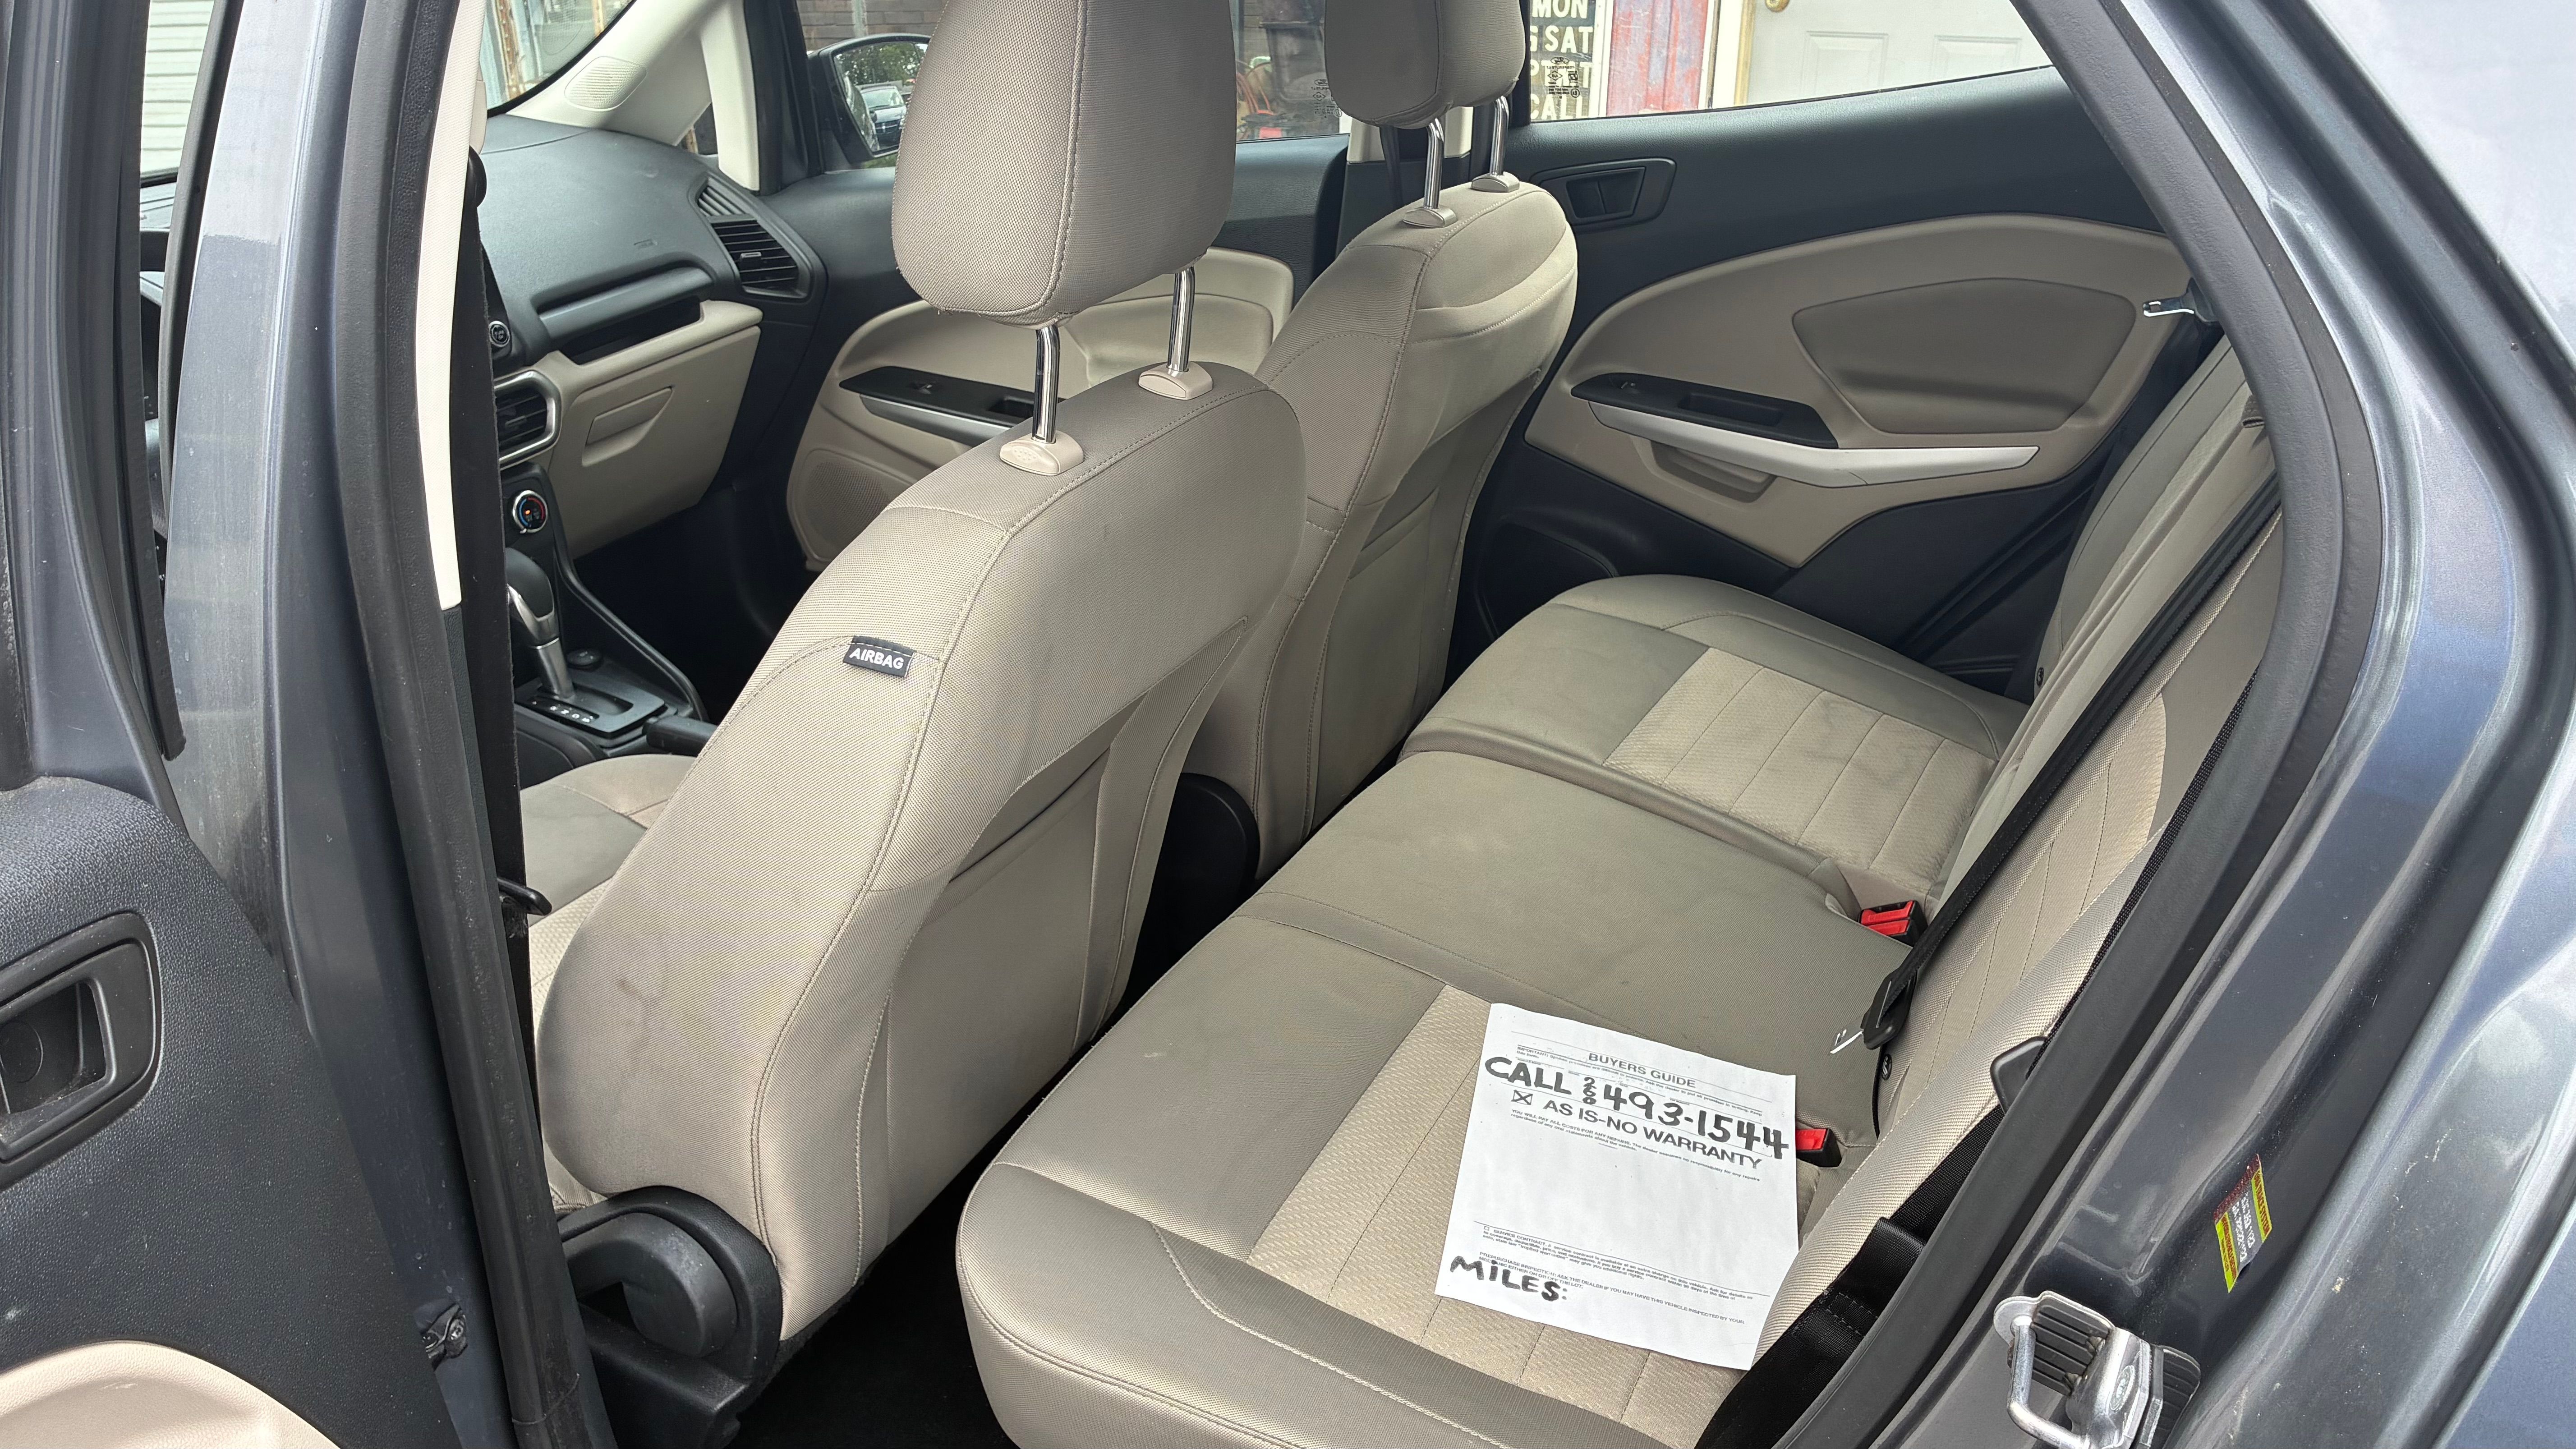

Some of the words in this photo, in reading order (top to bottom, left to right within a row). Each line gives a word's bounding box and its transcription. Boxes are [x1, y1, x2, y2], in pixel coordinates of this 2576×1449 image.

[1532, 0, 1588, 18] MON
[1545, 25, 1593, 53] SAT
[849, 648, 904, 669] AIRBAG
[1588, 1053, 1647, 1076] BUYERS
[1650, 1070, 1696, 1088] GUIDE
[1484, 1056, 1571, 1096] CALL
[1602, 1085, 1789, 1160] 493-1544
[1543, 1099, 1573, 1117] AS
[1578, 1106, 1637, 1135] IS-NO
[1643, 1127, 1762, 1170] WARRANTY
[1450, 1256, 1568, 1302] MILES:
[1664, 1301, 1688, 1311] VEHICLE
